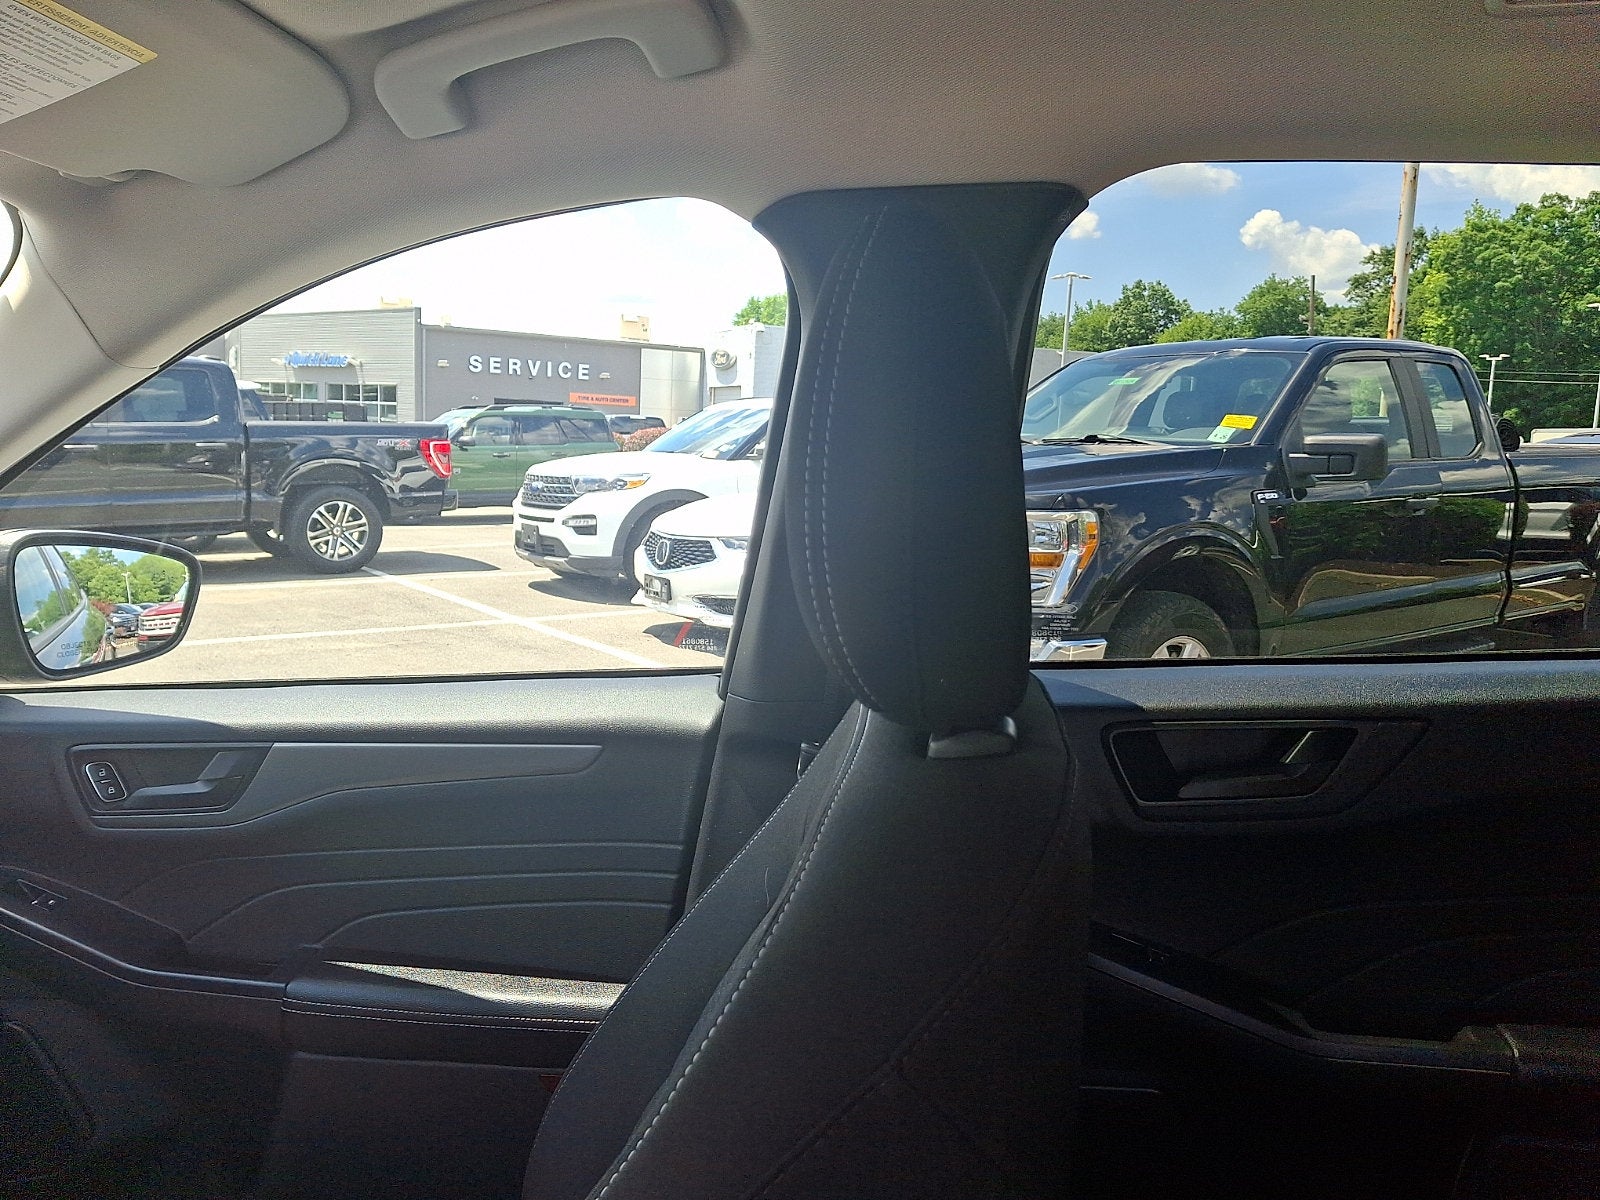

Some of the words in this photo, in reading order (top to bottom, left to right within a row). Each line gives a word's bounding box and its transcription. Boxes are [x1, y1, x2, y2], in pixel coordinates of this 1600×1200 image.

[7, 4, 31, 17] EVEN
[30, 15, 52, 27] WITH
[49, 25, 90, 46] ADVANCED
[89, 44, 102, 52] AIR
[101, 49, 121, 61] BAGS
[468, 355, 590, 380] SERVICE
[57, 650, 82, 658] CLOSE
